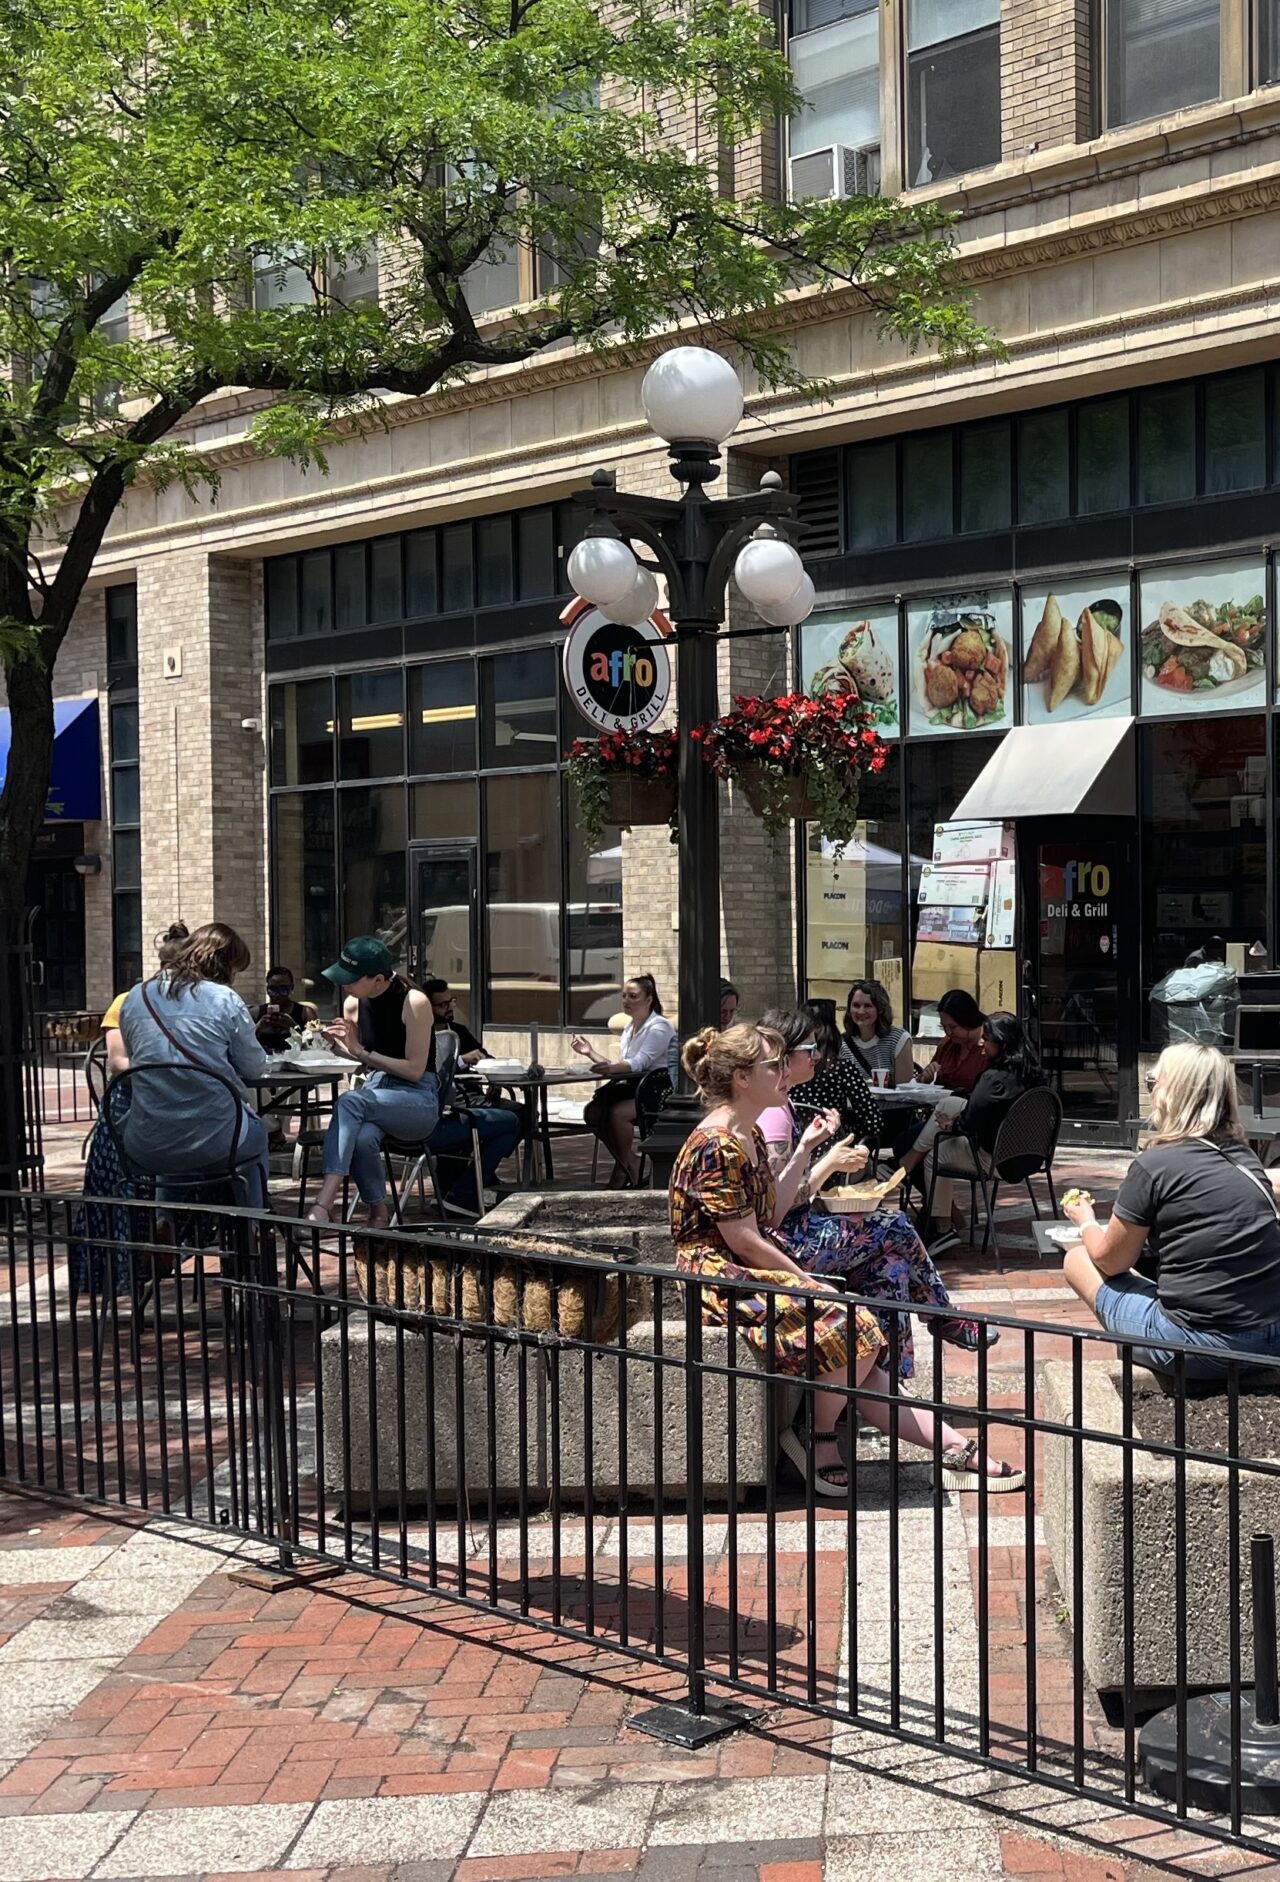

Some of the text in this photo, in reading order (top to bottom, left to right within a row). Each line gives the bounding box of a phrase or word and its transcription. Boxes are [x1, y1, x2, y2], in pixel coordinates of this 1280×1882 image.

[590, 650, 653, 688] afro
[576, 686, 665, 730] DELI & GRILL
[1047, 903, 1108, 917] Deli & Grill
[821, 941, 849, 951] PLACON
